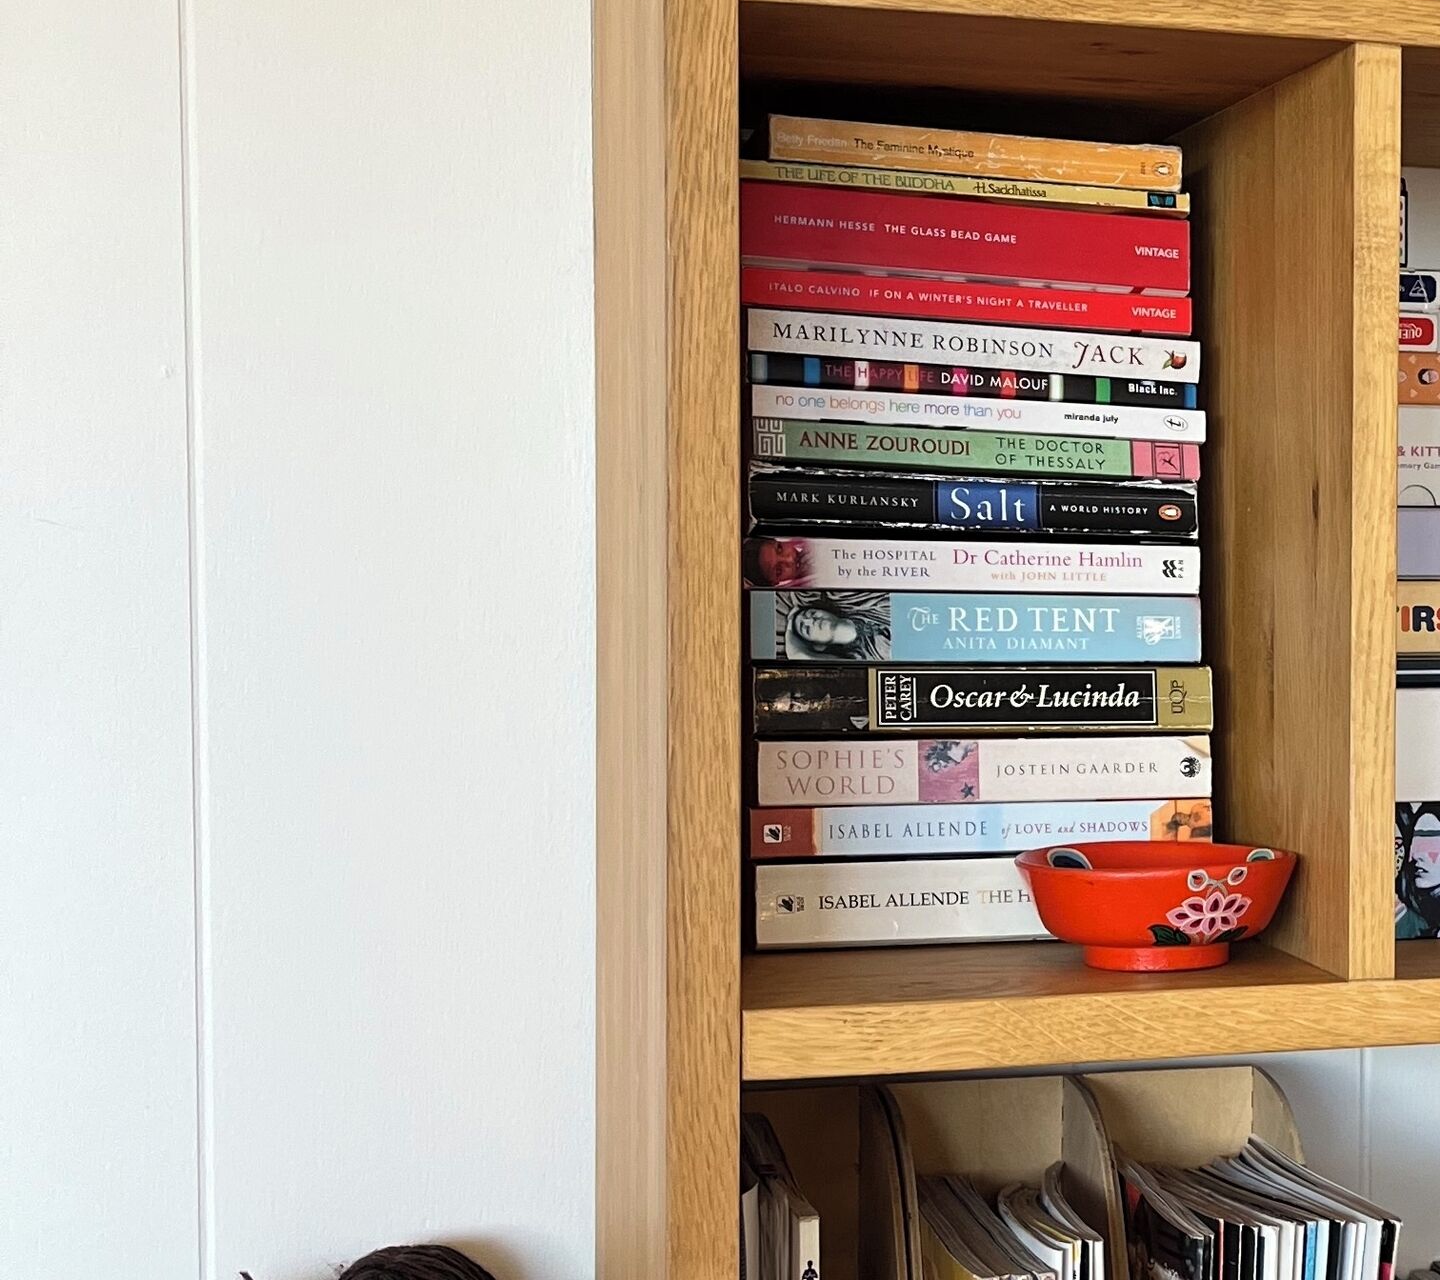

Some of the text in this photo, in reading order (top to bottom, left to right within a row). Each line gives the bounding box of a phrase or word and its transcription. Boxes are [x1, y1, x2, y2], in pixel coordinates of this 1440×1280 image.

[774, 214, 1017, 244] HERMANN HESSE THE GLASS BEAD GAME
[1134, 245, 1180, 260] VINTAGE
[1131, 306, 1178, 320] VINTAGE
[772, 322, 1145, 370] MARILYNNE ROBINSON JACK
[775, 393, 1022, 422] no one belongs here more than you
[799, 430, 970, 456] ANNE ZOUROUDI
[994, 436, 1105, 455] THE DOCTOR
[994, 453, 1106, 471] OF THESSALY
[776, 491, 919, 508] MARK KURLANSKY
[950, 487, 1026, 522] Salt
[862, 549, 937, 562] HOSPITAL
[952, 548, 1143, 568] Dr Catherine Hamlin
[881, 566, 931, 578] RIVER
[948, 606, 1019, 632] RED
[1027, 606, 1122, 632] TENT
[942, 636, 1090, 650] ANITA DIAMANT
[884, 674, 897, 720] PETER
[899, 673, 914, 722] CAREY
[929, 683, 1141, 709] Oscar Lucinda
[776, 748, 906, 770] SOPHIE'S
[995, 761, 1159, 779] JOSTEIN GAARDER
[786, 774, 896, 797] WORLD
[828, 821, 1149, 840] ISABEL ALLENDE LOVE SHADOWS
[818, 890, 970, 910] ISABEL ALLENDE
